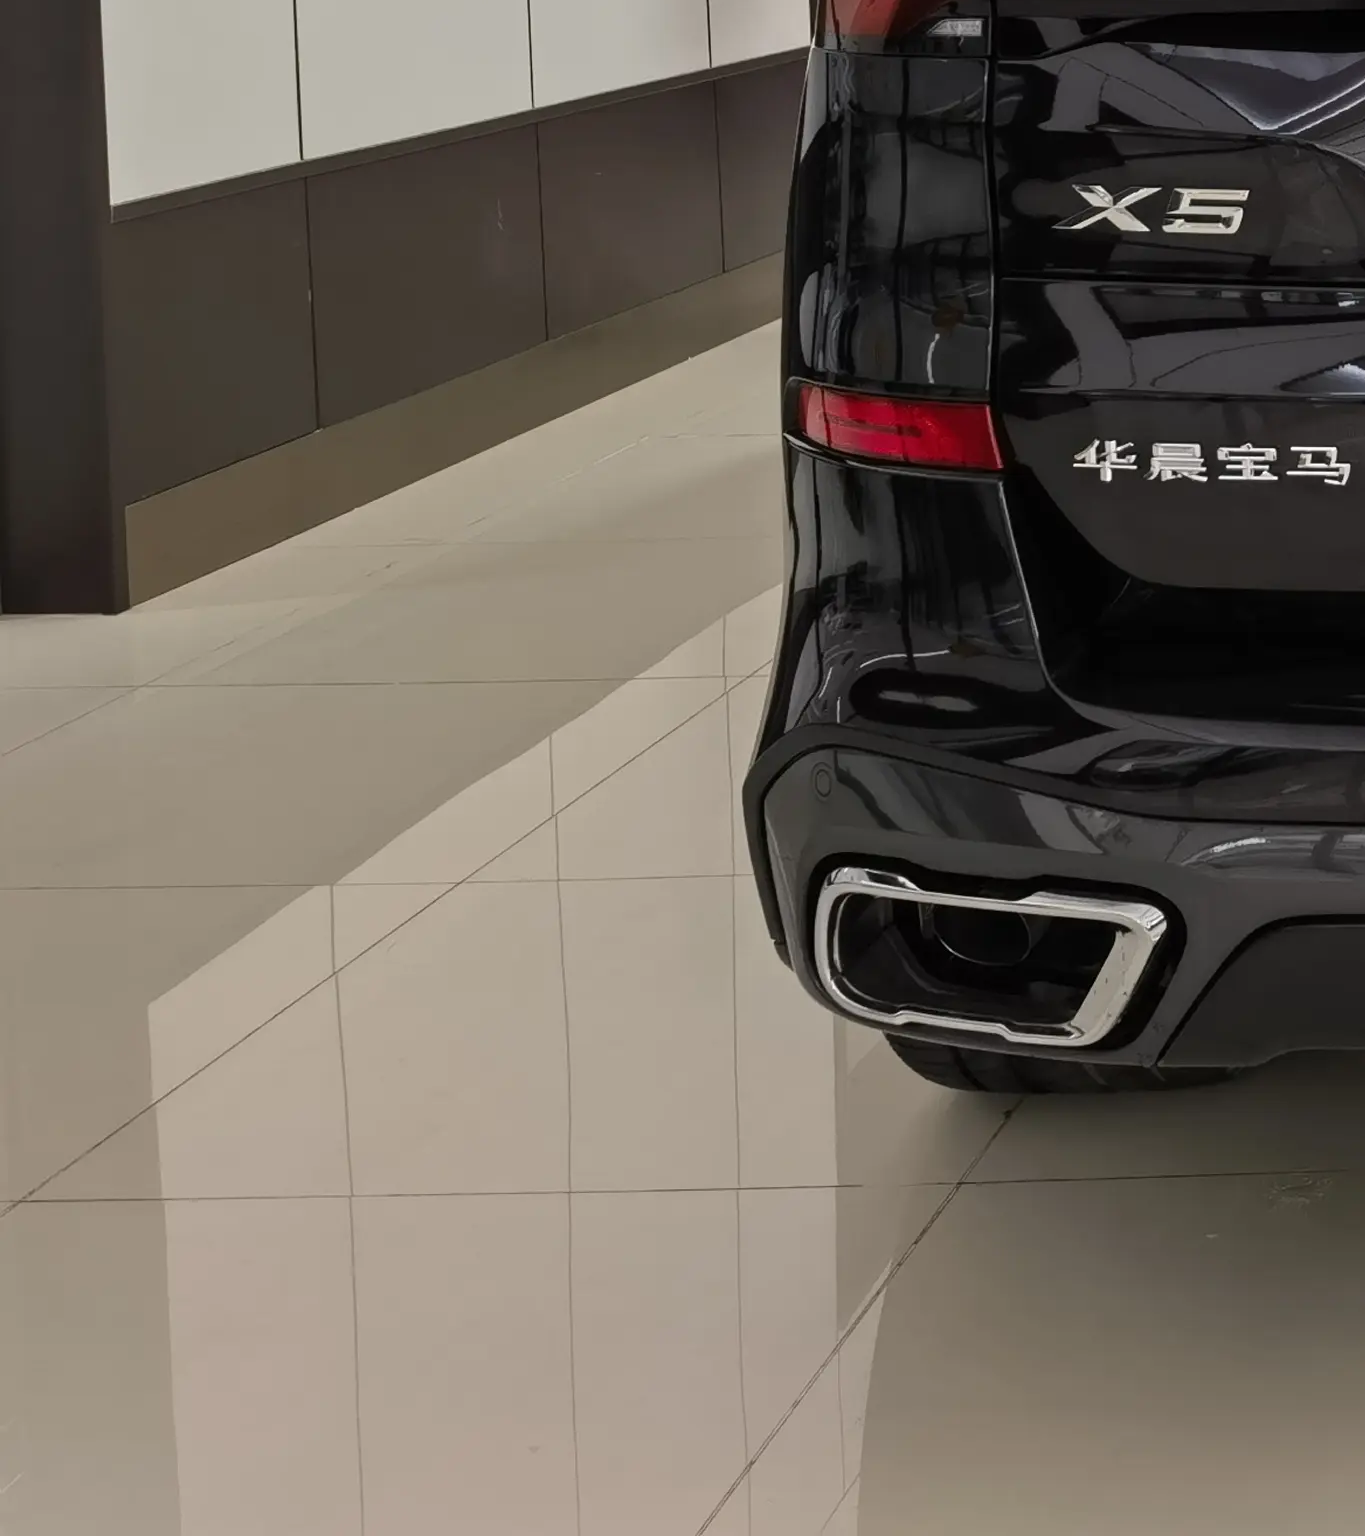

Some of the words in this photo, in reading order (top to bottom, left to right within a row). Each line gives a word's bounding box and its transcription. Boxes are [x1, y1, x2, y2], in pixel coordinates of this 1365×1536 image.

[1051, 183, 1250, 234] X5
[1072, 439, 1351, 486] 华晨宝马
